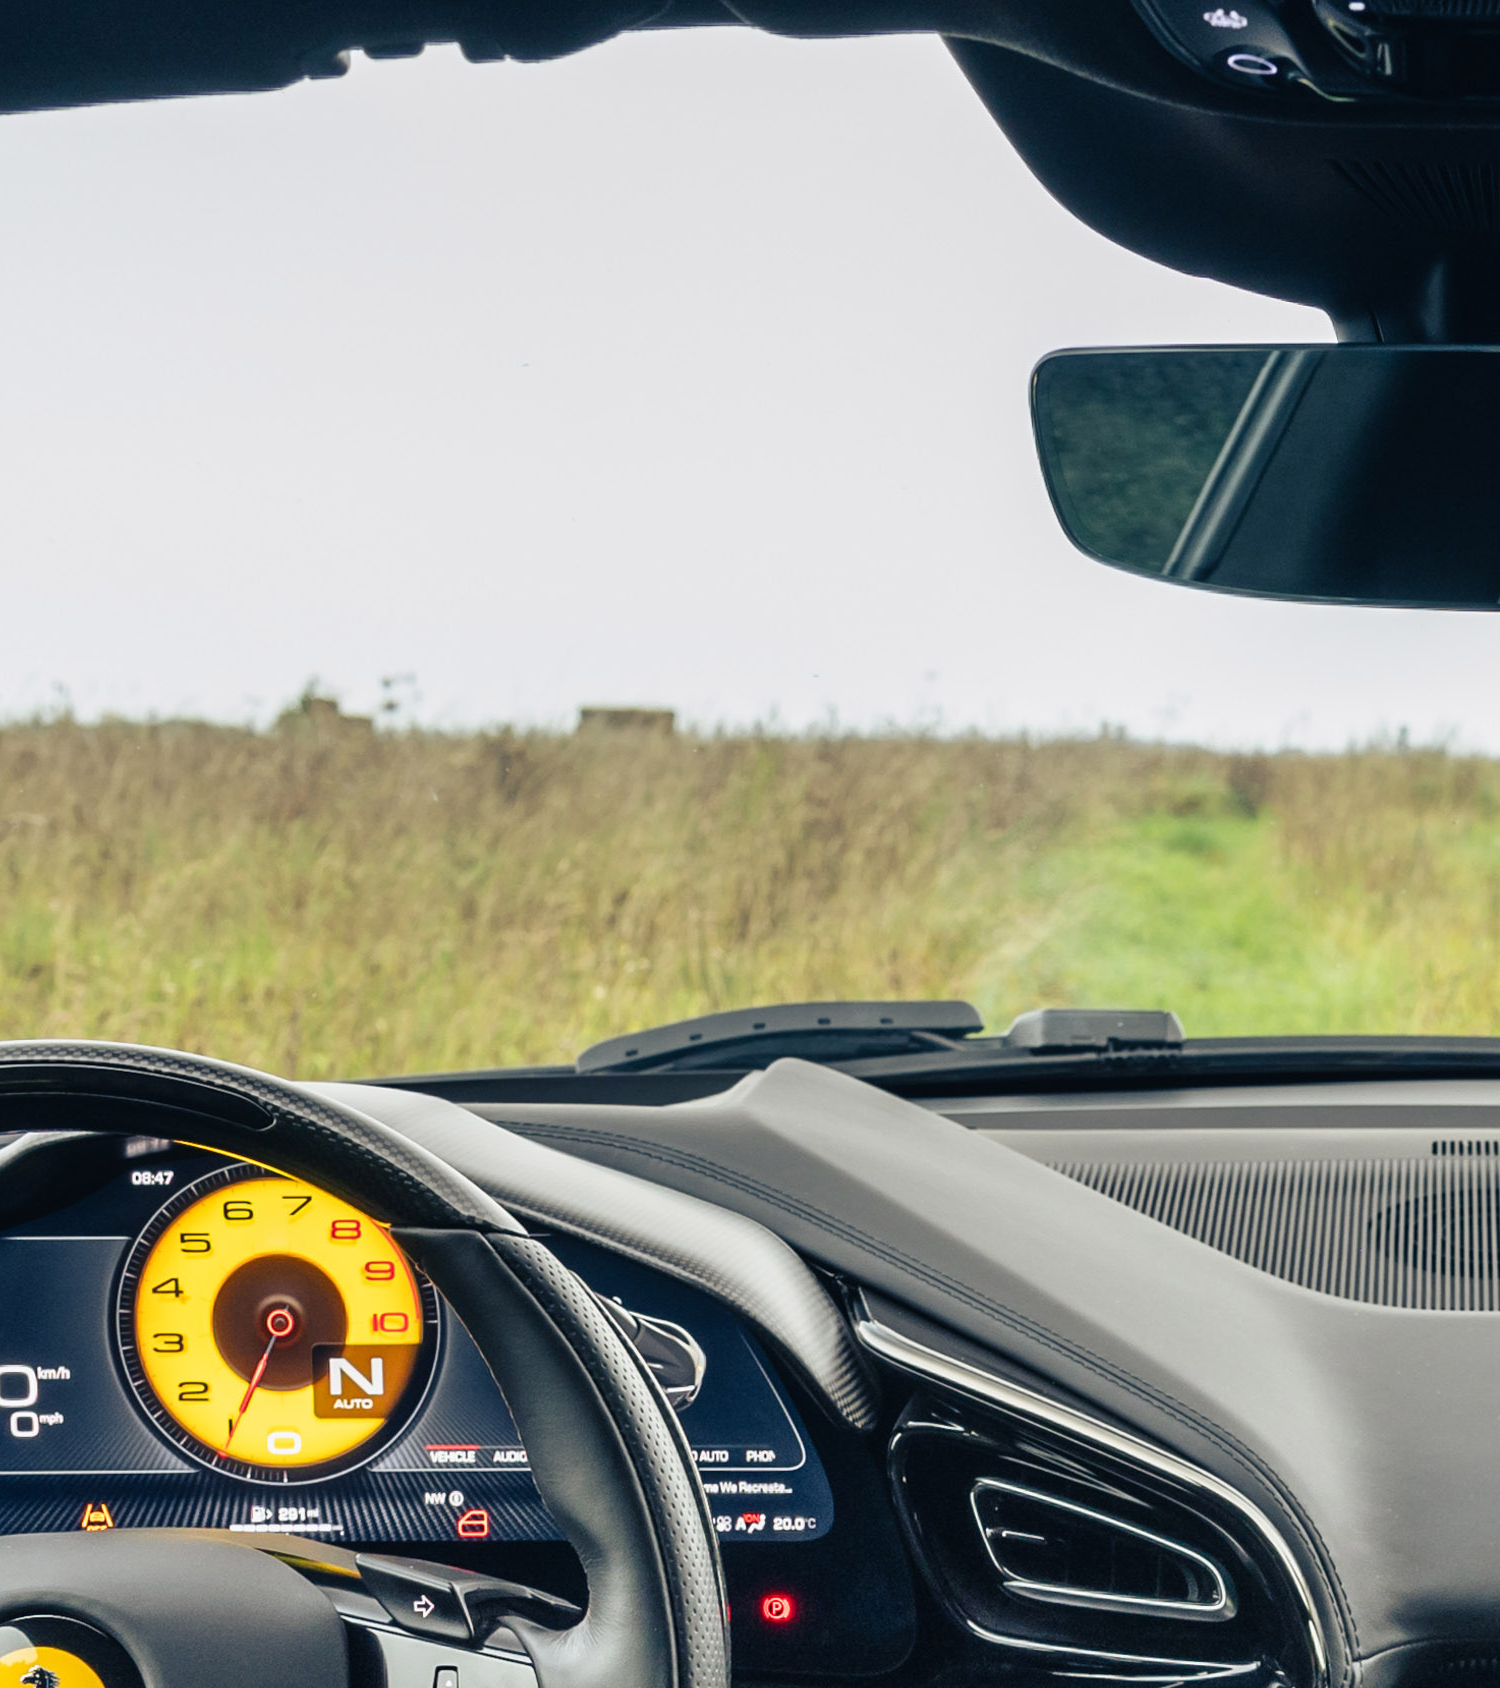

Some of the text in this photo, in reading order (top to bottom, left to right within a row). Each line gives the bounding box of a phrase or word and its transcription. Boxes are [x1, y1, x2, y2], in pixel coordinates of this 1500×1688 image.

[131, 1170, 174, 1186] 08:47
[223, 1200, 254, 1221] 6
[282, 1195, 312, 1216] 7
[330, 1219, 362, 1240] 8
[180, 1232, 212, 1253] 5
[364, 1260, 396, 1281] 9
[151, 1277, 184, 1298] 4
[372, 1312, 409, 1333] 10
[152, 1333, 184, 1353] 3
[36, 1366, 71, 1380] km/h
[328, 1357, 384, 1396] N
[178, 1381, 210, 1402] 2
[333, 1398, 373, 1410] AUTO
[39, 1411, 64, 1426] mph
[267, 1431, 301, 1455] 0
[429, 1450, 476, 1463] VEHICLE
[700, 1450, 729, 1462] AUTO
[424, 1492, 446, 1505] NW
